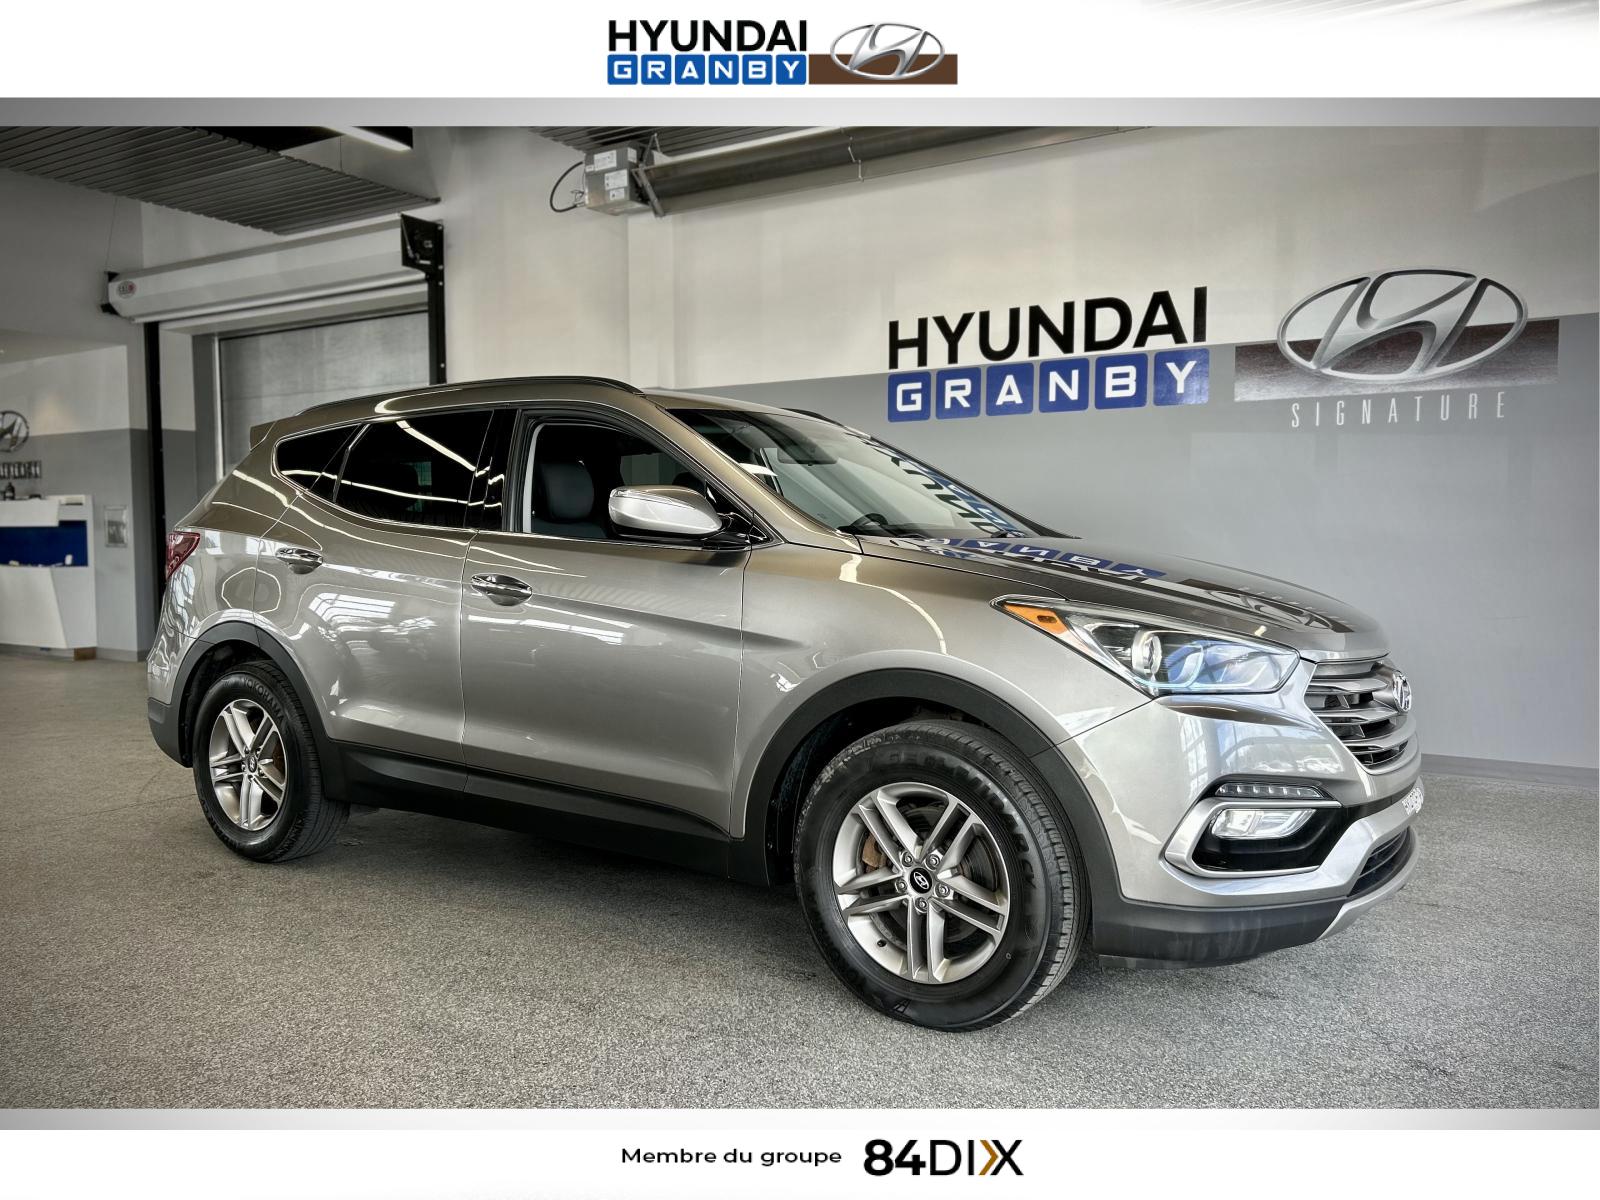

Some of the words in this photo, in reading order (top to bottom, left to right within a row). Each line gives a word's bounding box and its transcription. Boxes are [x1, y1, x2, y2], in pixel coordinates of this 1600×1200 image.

[889, 286, 1207, 368] HYUNDAI
[896, 360, 1196, 413] GRANBY
[1291, 391, 1505, 428] SIGNATURE
